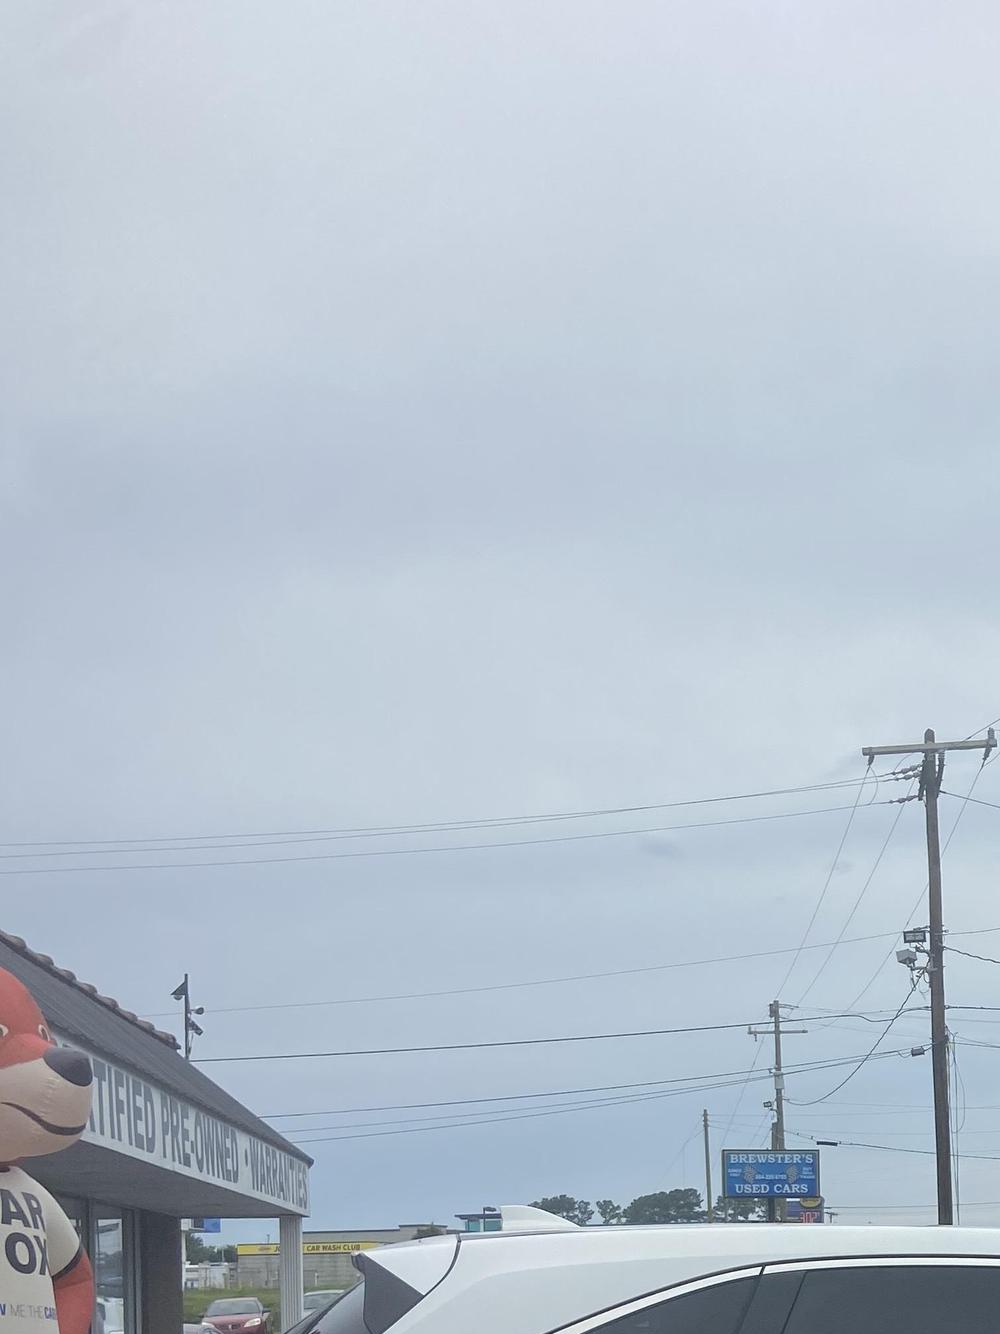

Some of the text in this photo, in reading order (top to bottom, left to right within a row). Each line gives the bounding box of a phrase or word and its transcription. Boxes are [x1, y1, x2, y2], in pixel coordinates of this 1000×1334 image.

[90, 1058, 308, 1210] TIFIED PRE-OWNED WARRANTIES
[730, 1154, 813, 1163] BREWSTER'S
[735, 1184, 808, 1193] USED CARS
[10, 1304, 25, 1318] ME
[28, 1305, 43, 1319] THE
